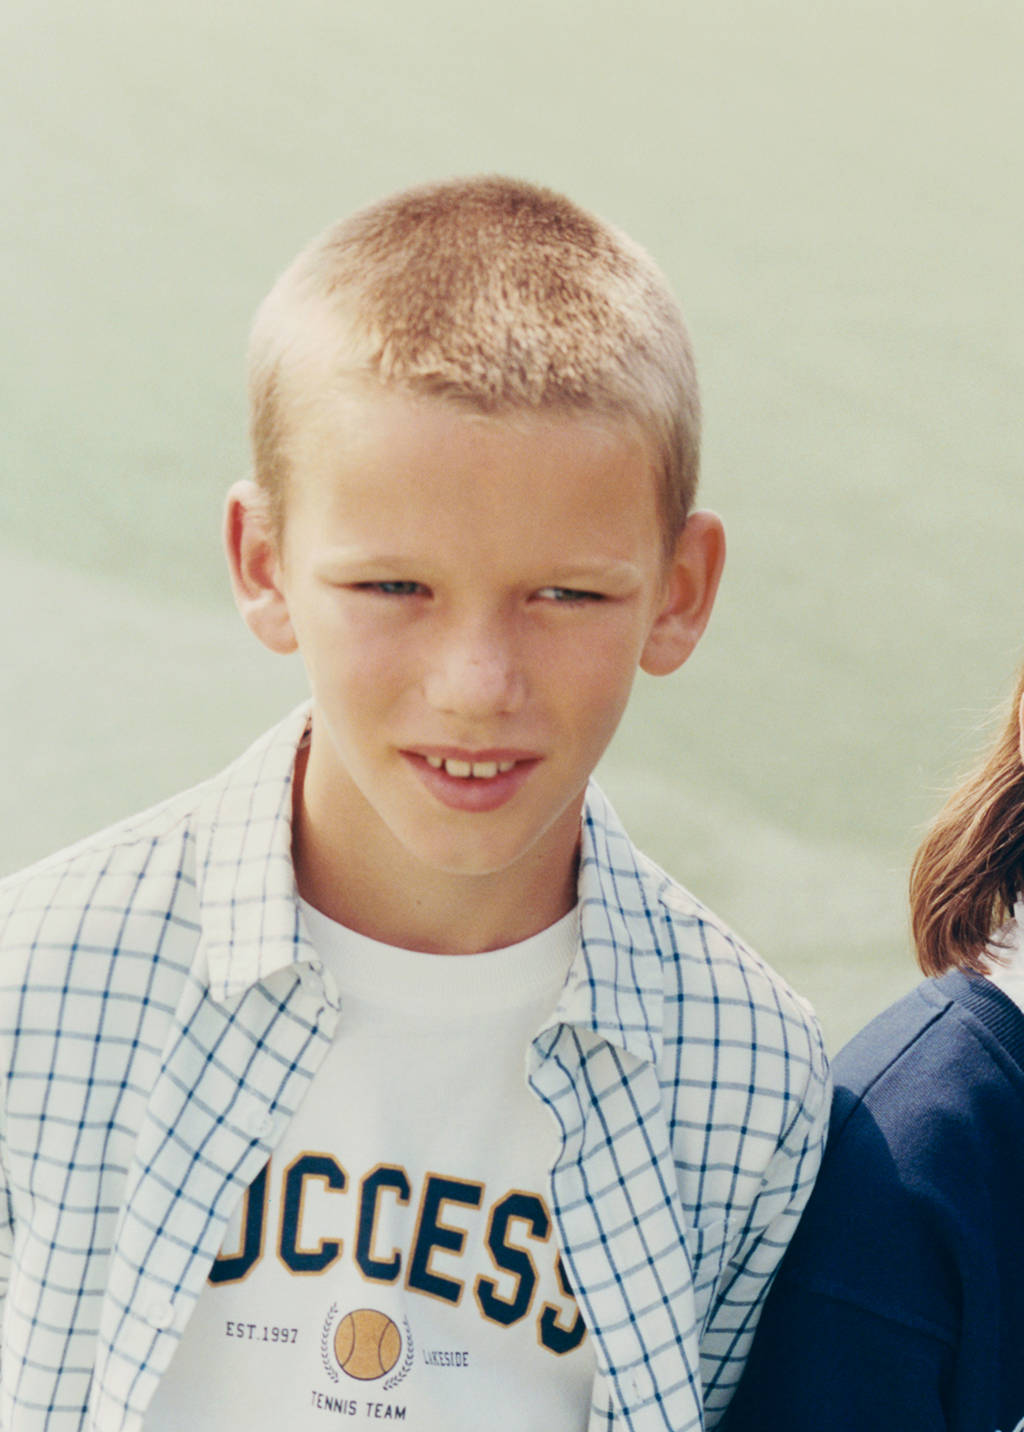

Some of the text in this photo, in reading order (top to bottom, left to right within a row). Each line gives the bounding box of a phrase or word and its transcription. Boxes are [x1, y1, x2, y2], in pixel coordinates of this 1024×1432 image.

[225, 1321, 298, 1344] EST.1997
[422, 1349, 469, 1367] LAKESIDE
[311, 1390, 407, 1420] TENNIS TEAM
